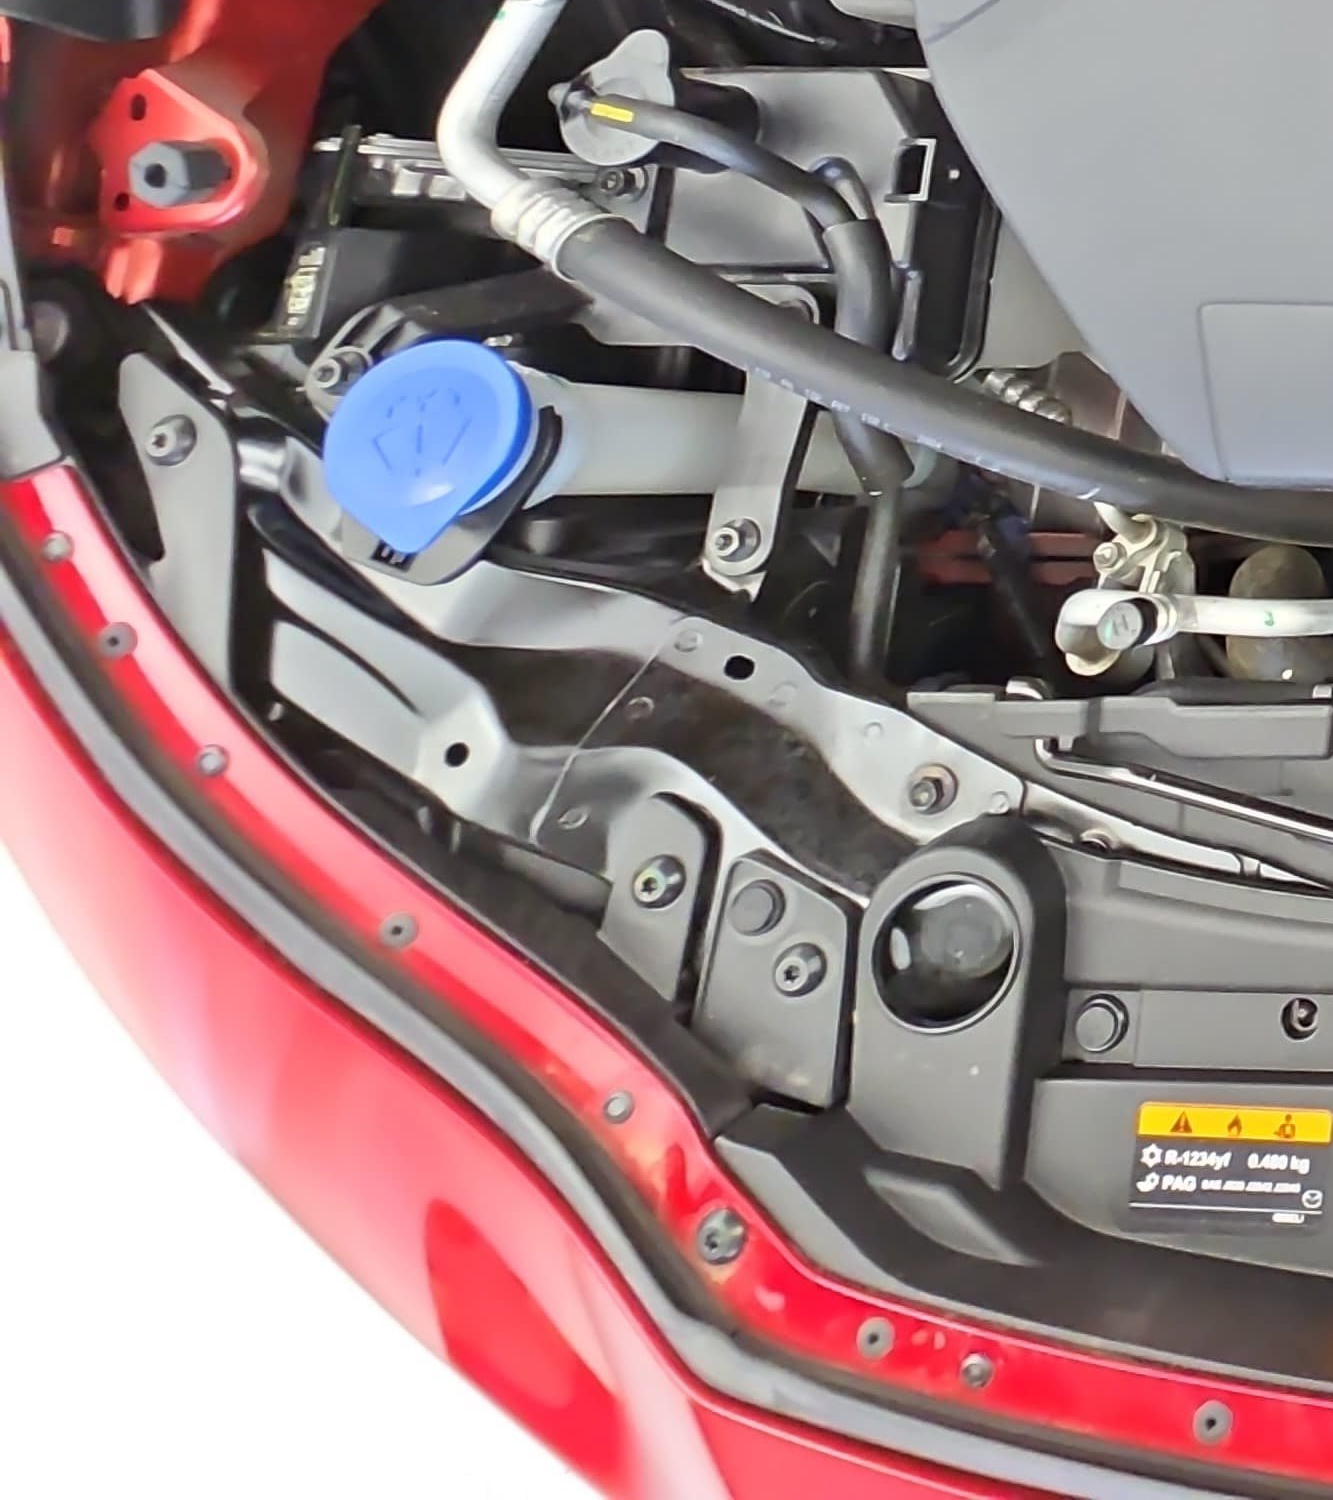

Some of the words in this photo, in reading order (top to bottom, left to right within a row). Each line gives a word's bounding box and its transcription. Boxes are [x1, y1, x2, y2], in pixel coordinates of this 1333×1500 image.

[1164, 1149, 1233, 1171] R-1234yf
[1290, 1155, 1310, 1174] kg
[1161, 1174, 1198, 1192] PAG
